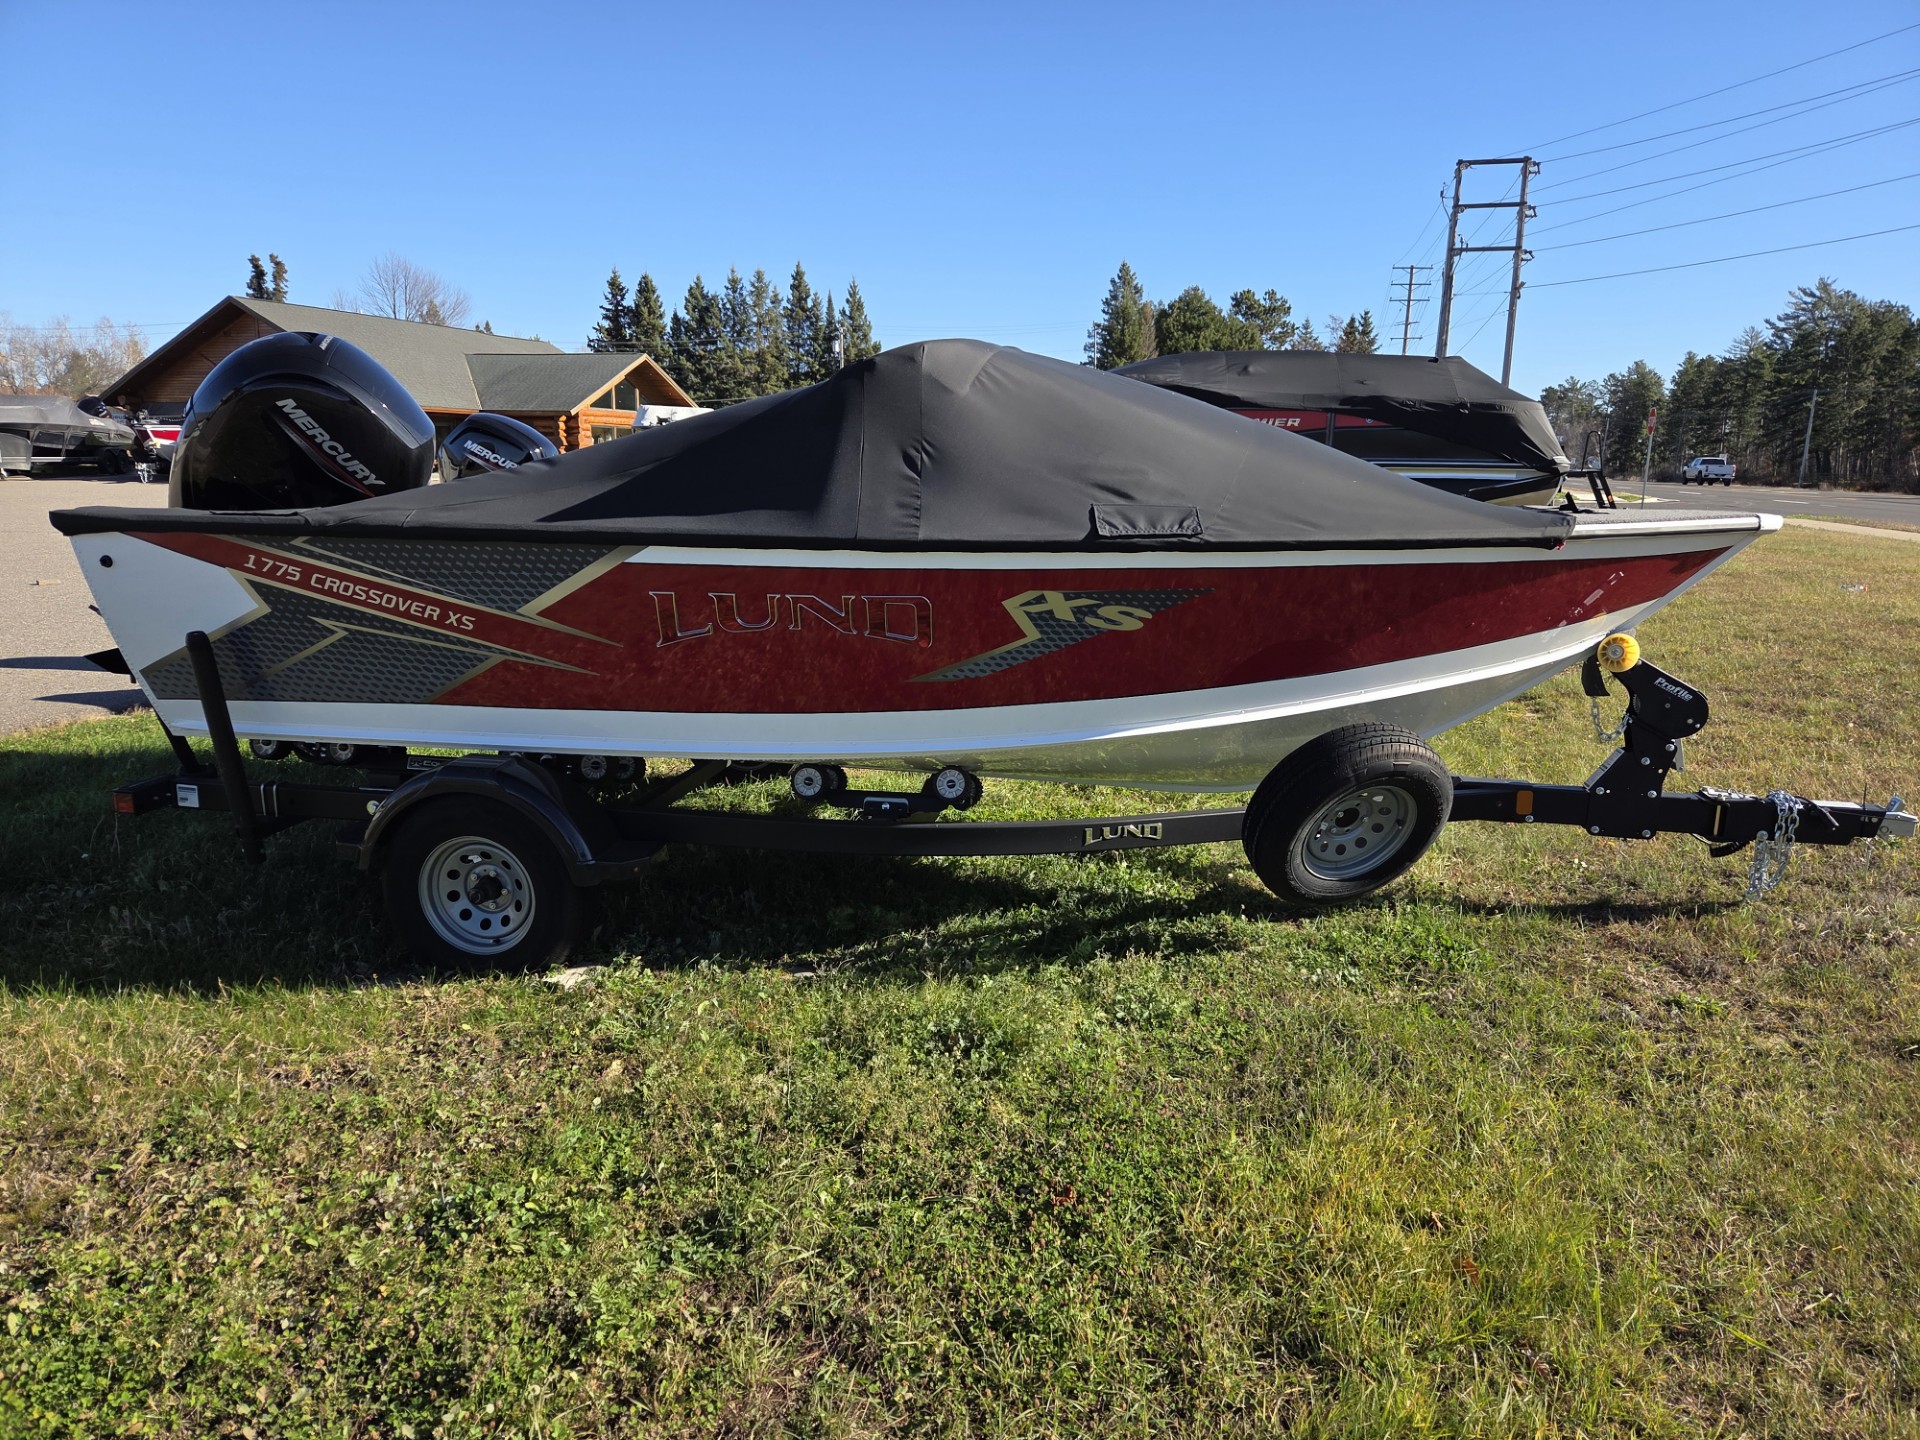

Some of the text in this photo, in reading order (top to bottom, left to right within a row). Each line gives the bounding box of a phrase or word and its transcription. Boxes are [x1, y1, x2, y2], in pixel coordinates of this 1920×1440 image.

[275, 398, 386, 486] MERCURY
[463, 439, 520, 469] MERCUR
[243, 554, 477, 631] 1775 CROSSOVER XS
[649, 591, 933, 648] LUND
[1654, 677, 1693, 700] Profile
[1084, 822, 1163, 847] LUND
